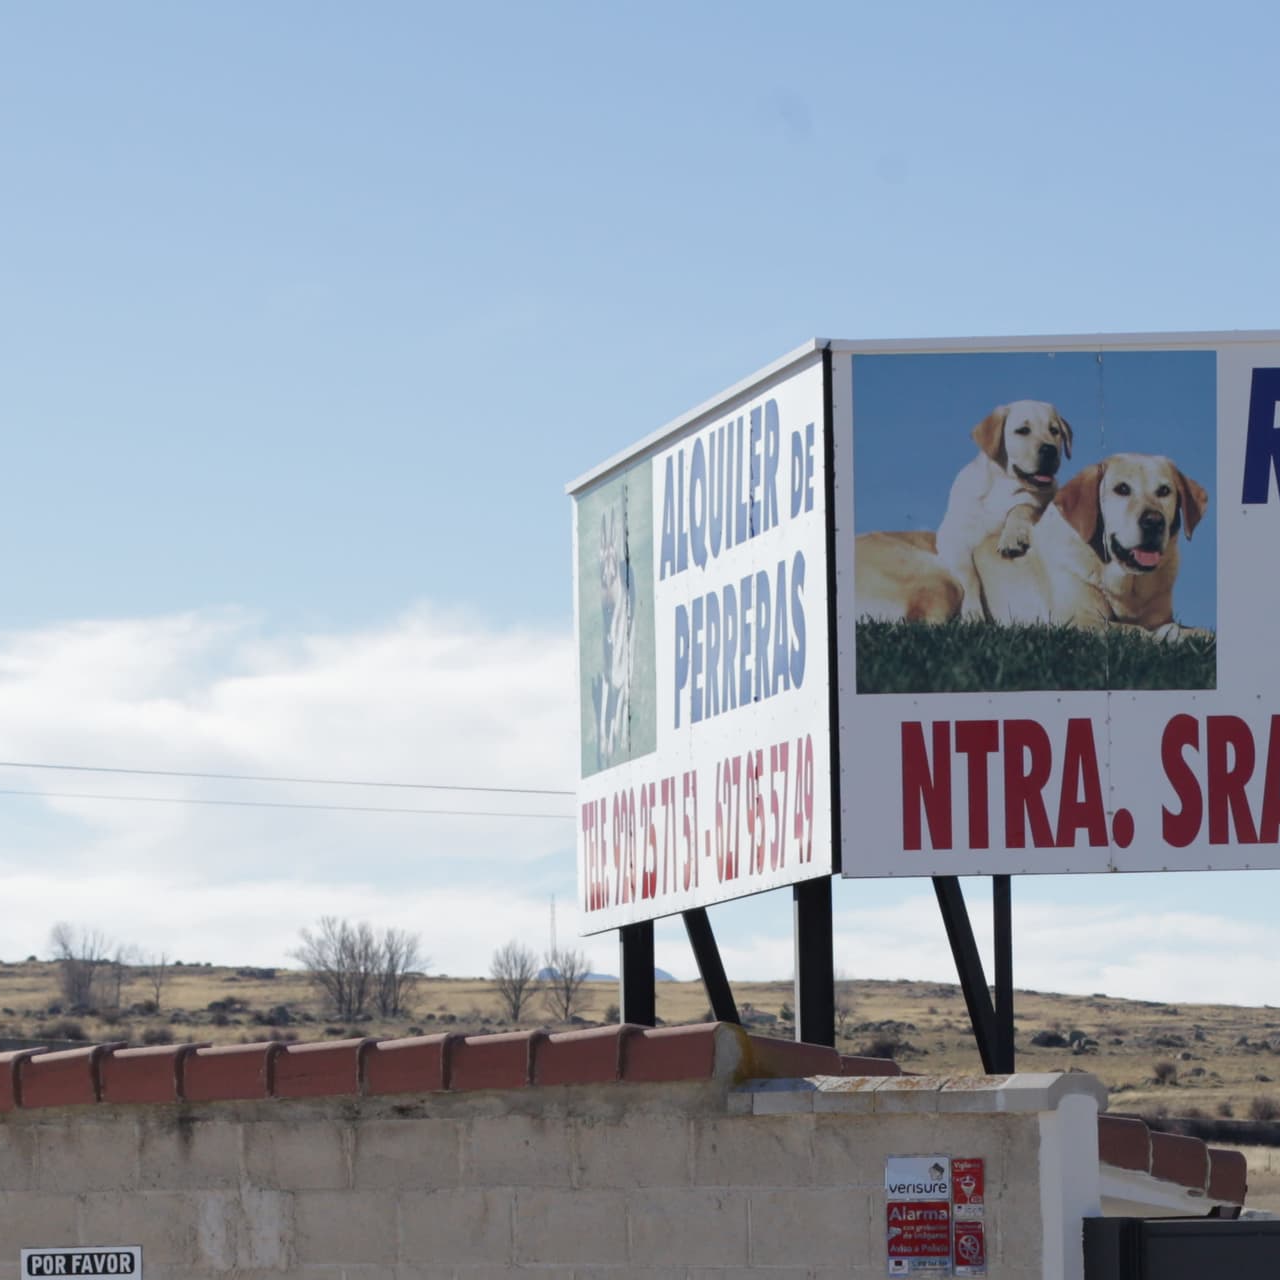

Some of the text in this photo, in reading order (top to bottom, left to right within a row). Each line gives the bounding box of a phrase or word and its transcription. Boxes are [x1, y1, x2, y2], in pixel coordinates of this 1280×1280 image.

[659, 397, 815, 581] ALQUILER DE
[674, 550, 806, 730] PERRERAS
[613, 787, 636, 906] 920
[640, 782, 657, 900] 25
[661, 776, 677, 895] 71
[683, 770, 699, 892] 51
[716, 756, 741, 884] 627
[746, 749, 765, 876] 95
[770, 741, 789, 872] 57
[794, 733, 814, 864] 49
[901, 716, 1135, 851] NTRA.
[889, 1182, 947, 1194] verisure
[889, 1206, 947, 1221] Alarma
[31, 1253, 131, 1274] POR FAVOR
